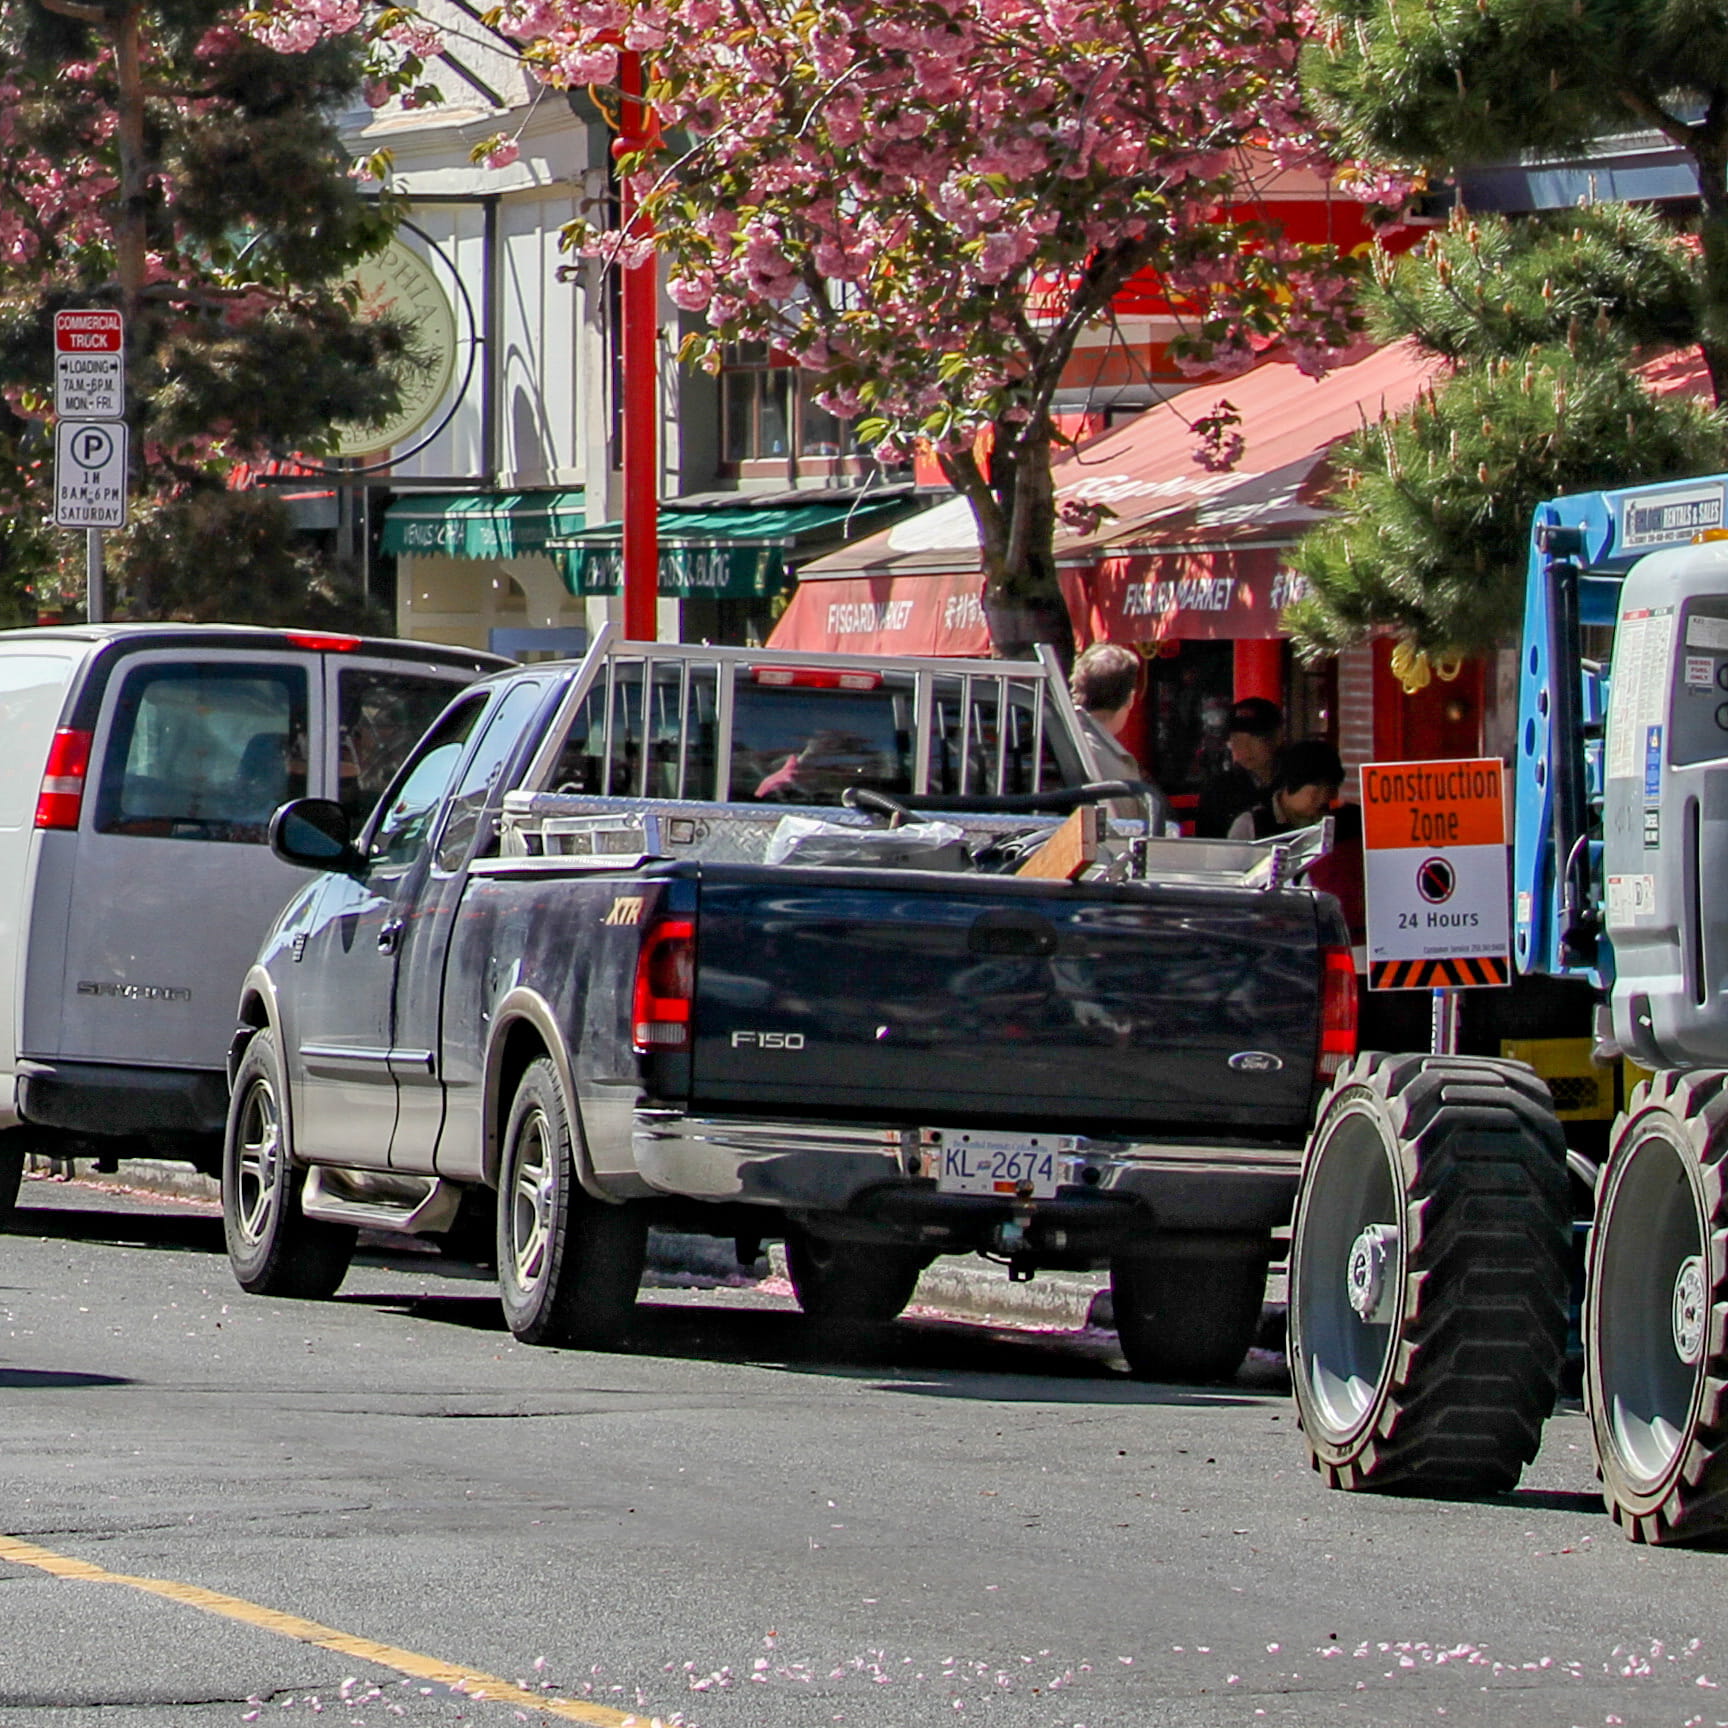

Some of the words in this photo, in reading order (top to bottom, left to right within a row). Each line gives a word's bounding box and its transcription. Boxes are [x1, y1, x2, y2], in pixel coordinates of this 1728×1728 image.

[57, 316, 121, 330] COMMERCIAL
[70, 333, 108, 348] TRUCK
[69, 359, 109, 374] LOADING
[84, 435, 103, 460] P
[61, 507, 119, 521] SATURDAY
[1176, 578, 1236, 610] MARKET
[827, 602, 876, 634] FISGARD
[875, 600, 914, 631] MARKET
[1367, 763, 1499, 804] Construction
[1410, 808, 1459, 842] Zone
[605, 896, 644, 926] XTR
[1398, 912, 1419, 930] 24
[1427, 912, 1480, 929] Hours
[731, 1030, 805, 1050] F-150
[945, 1148, 975, 1178] KL
[990, 1152, 1053, 1181] 2674
